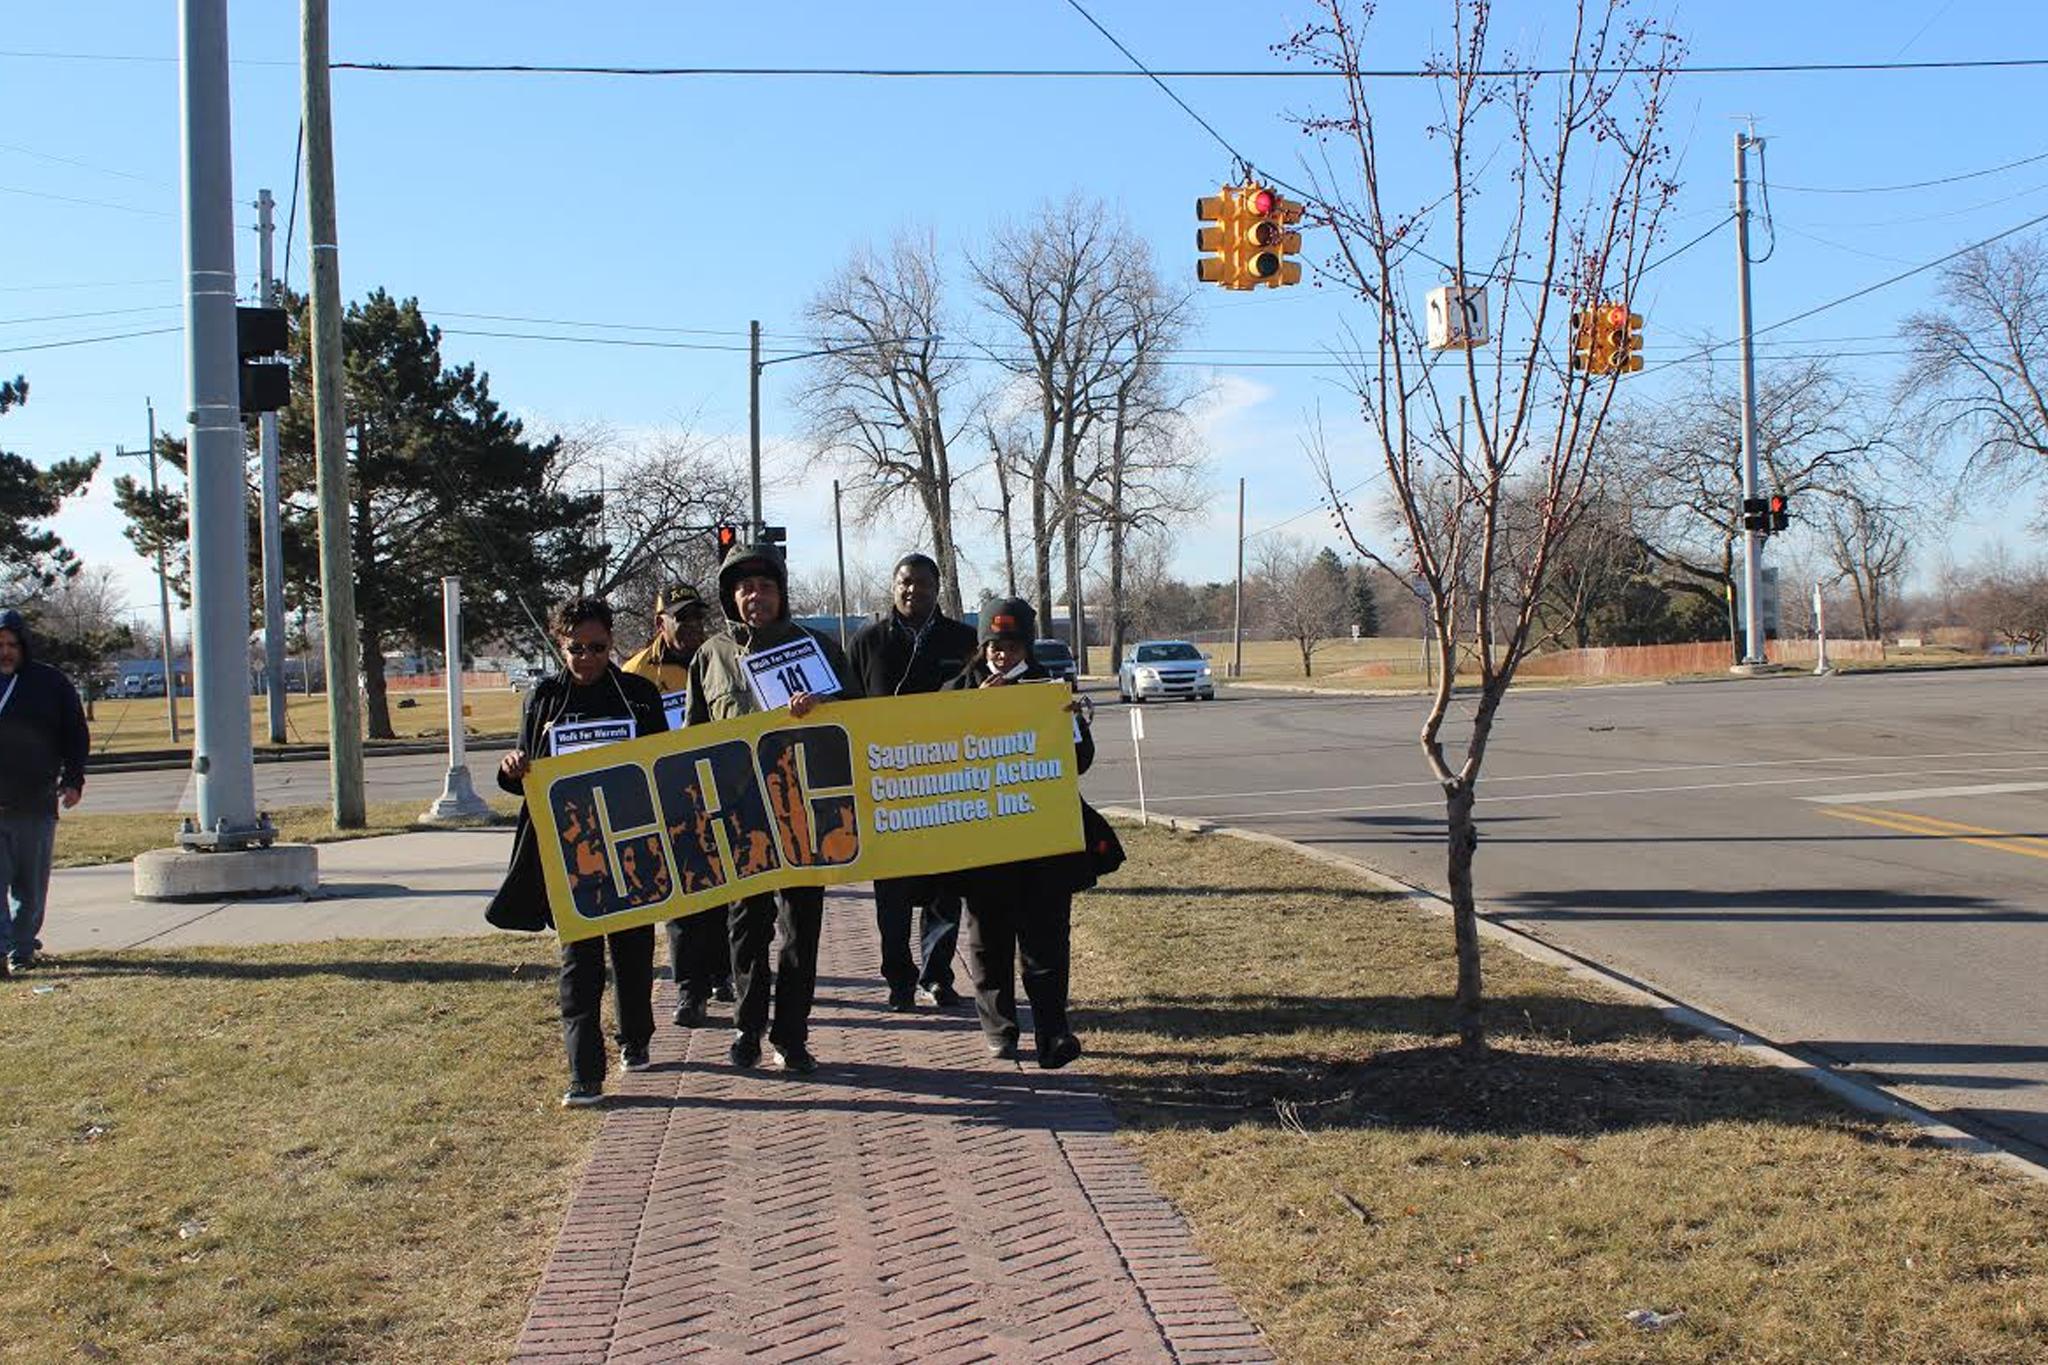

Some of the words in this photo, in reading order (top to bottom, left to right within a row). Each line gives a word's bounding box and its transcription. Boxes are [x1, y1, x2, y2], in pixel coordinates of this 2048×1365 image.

[777, 663, 813, 696] 141
[558, 731, 578, 742] Walk
[579, 731, 593, 740] For
[867, 739, 959, 771] Saginaw
[963, 730, 1037, 761] County
[870, 766, 992, 803] Community
[994, 757, 1063, 787] Action
[996, 791, 1036, 817] Inc.
